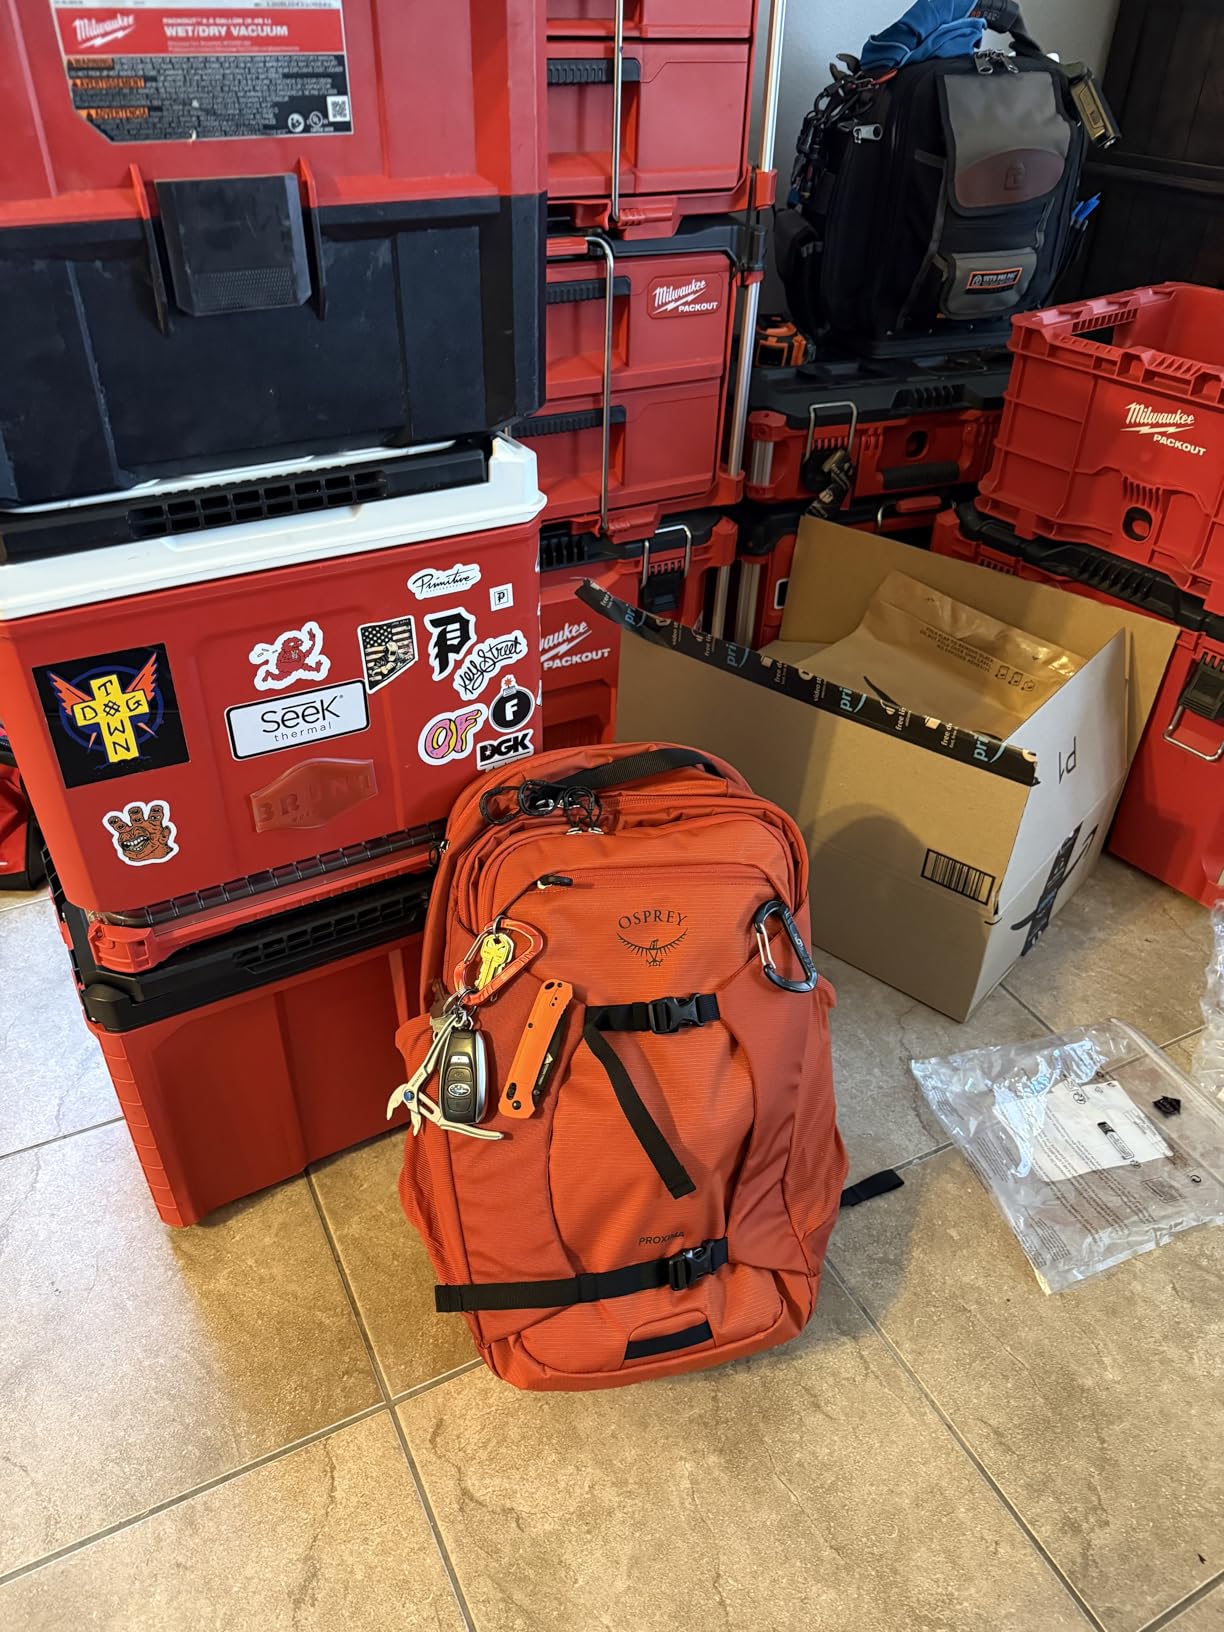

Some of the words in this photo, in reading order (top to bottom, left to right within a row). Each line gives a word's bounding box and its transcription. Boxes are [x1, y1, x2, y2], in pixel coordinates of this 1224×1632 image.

[73, 13, 135, 42] Milwaukee
[164, 25, 227, 38] WET/DRY
[231, 25, 289, 38] VACUUM
[652, 279, 706, 308] Milwaukee
[678, 301, 718, 313] PACKOUT
[1124, 401, 1195, 424] Milwaukee
[1153, 434, 1206, 456] PACKOUT
[412, 568, 477, 595] Primitive
[428, 612, 472, 676] P
[543, 648, 612, 671] PACKOUT
[504, 698, 519, 721] F
[274, 721, 332, 742] thermal
[425, 708, 482, 760] OF
[480, 731, 531, 763] DGK
[618, 909, 688, 930] OSPREY
[638, 1231, 685, 1246] PROXIMA
